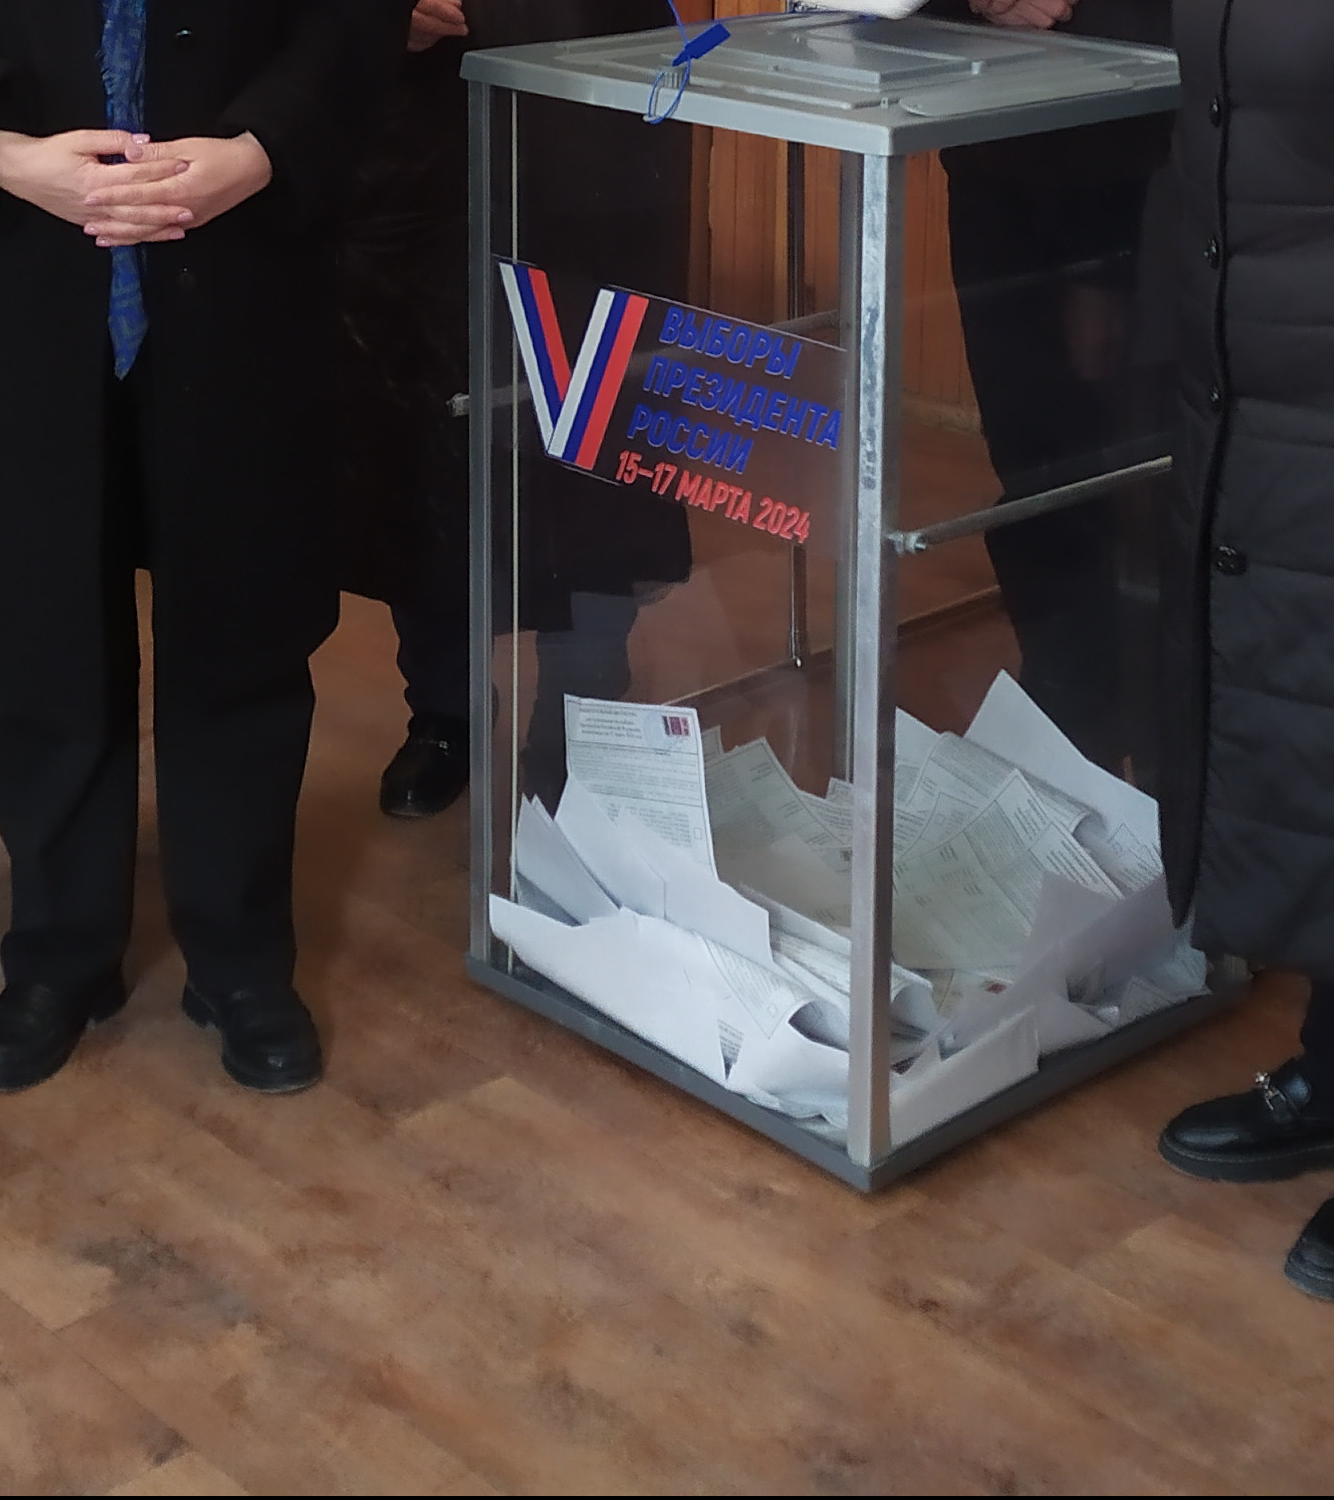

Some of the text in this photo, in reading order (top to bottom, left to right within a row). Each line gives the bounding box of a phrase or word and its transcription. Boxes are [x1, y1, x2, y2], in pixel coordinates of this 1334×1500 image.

[659, 304, 802, 381] ВЫБОРЫ
[626, 403, 755, 476] РОССИИ
[642, 354, 845, 451] ПРЕЗИДЕНТА
[674, 469, 753, 526] МАРТА
[752, 495, 811, 546] 2024
